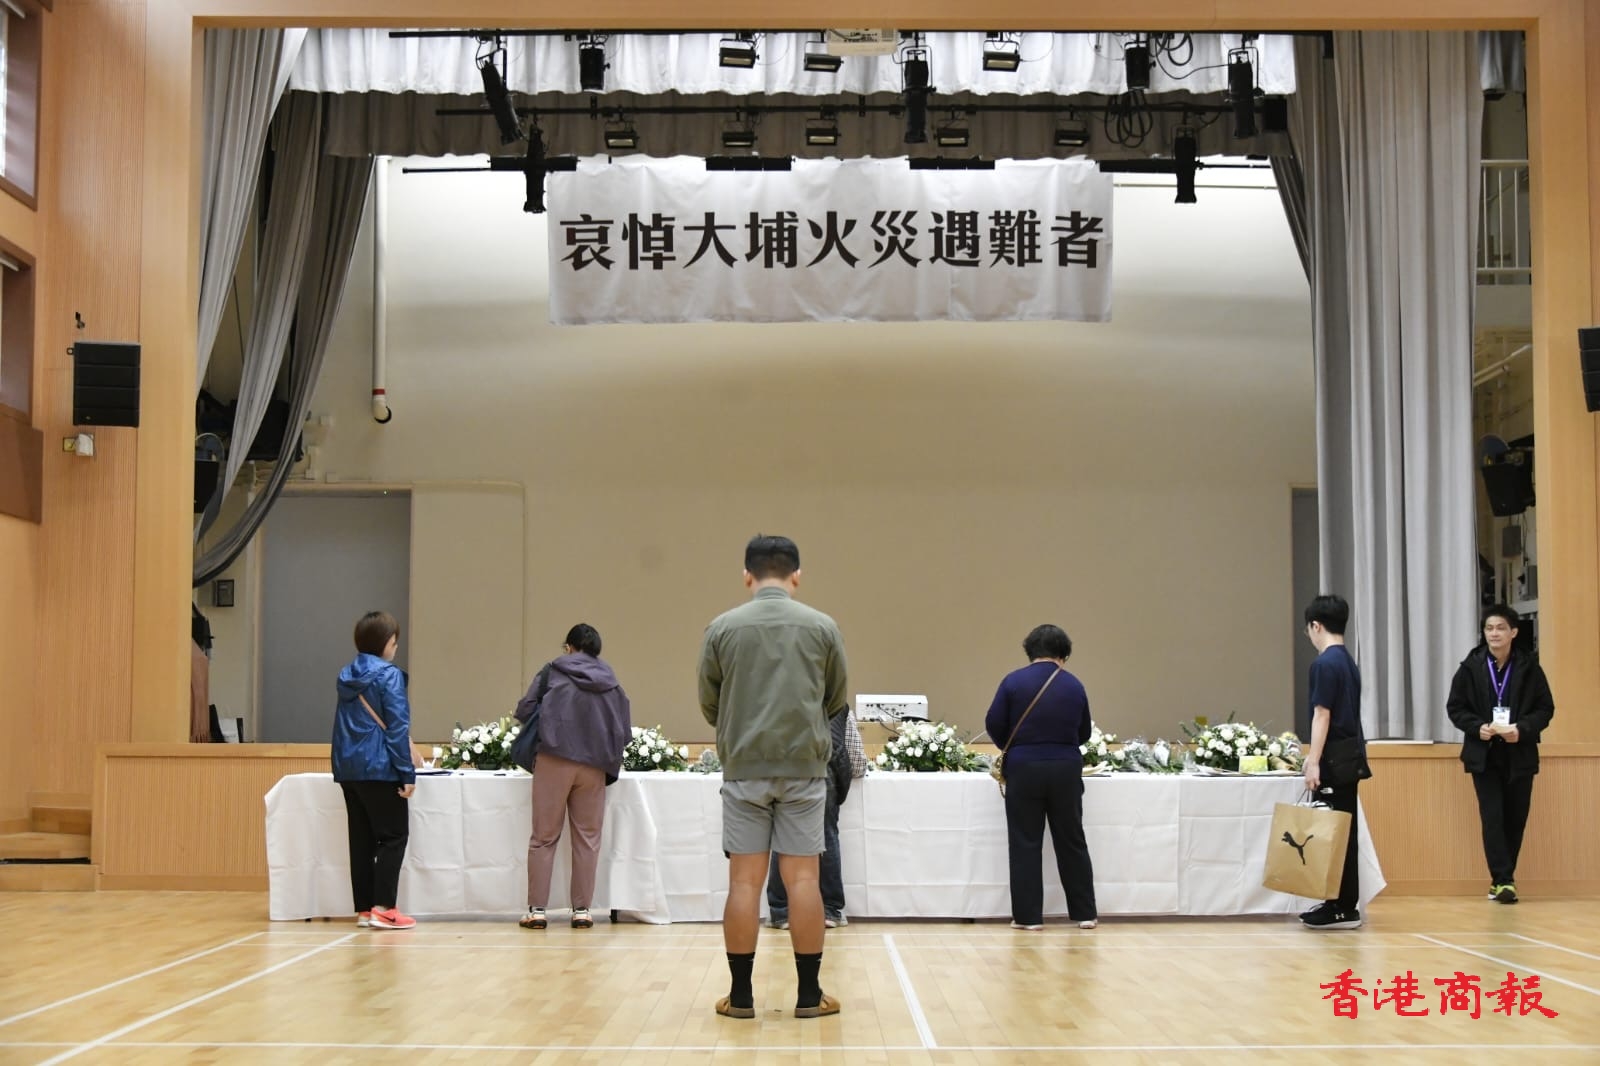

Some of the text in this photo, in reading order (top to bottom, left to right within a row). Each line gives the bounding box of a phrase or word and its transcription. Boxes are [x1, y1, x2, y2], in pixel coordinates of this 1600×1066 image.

[559, 209, 1104, 271] 哀悼大埔火災遇難者
